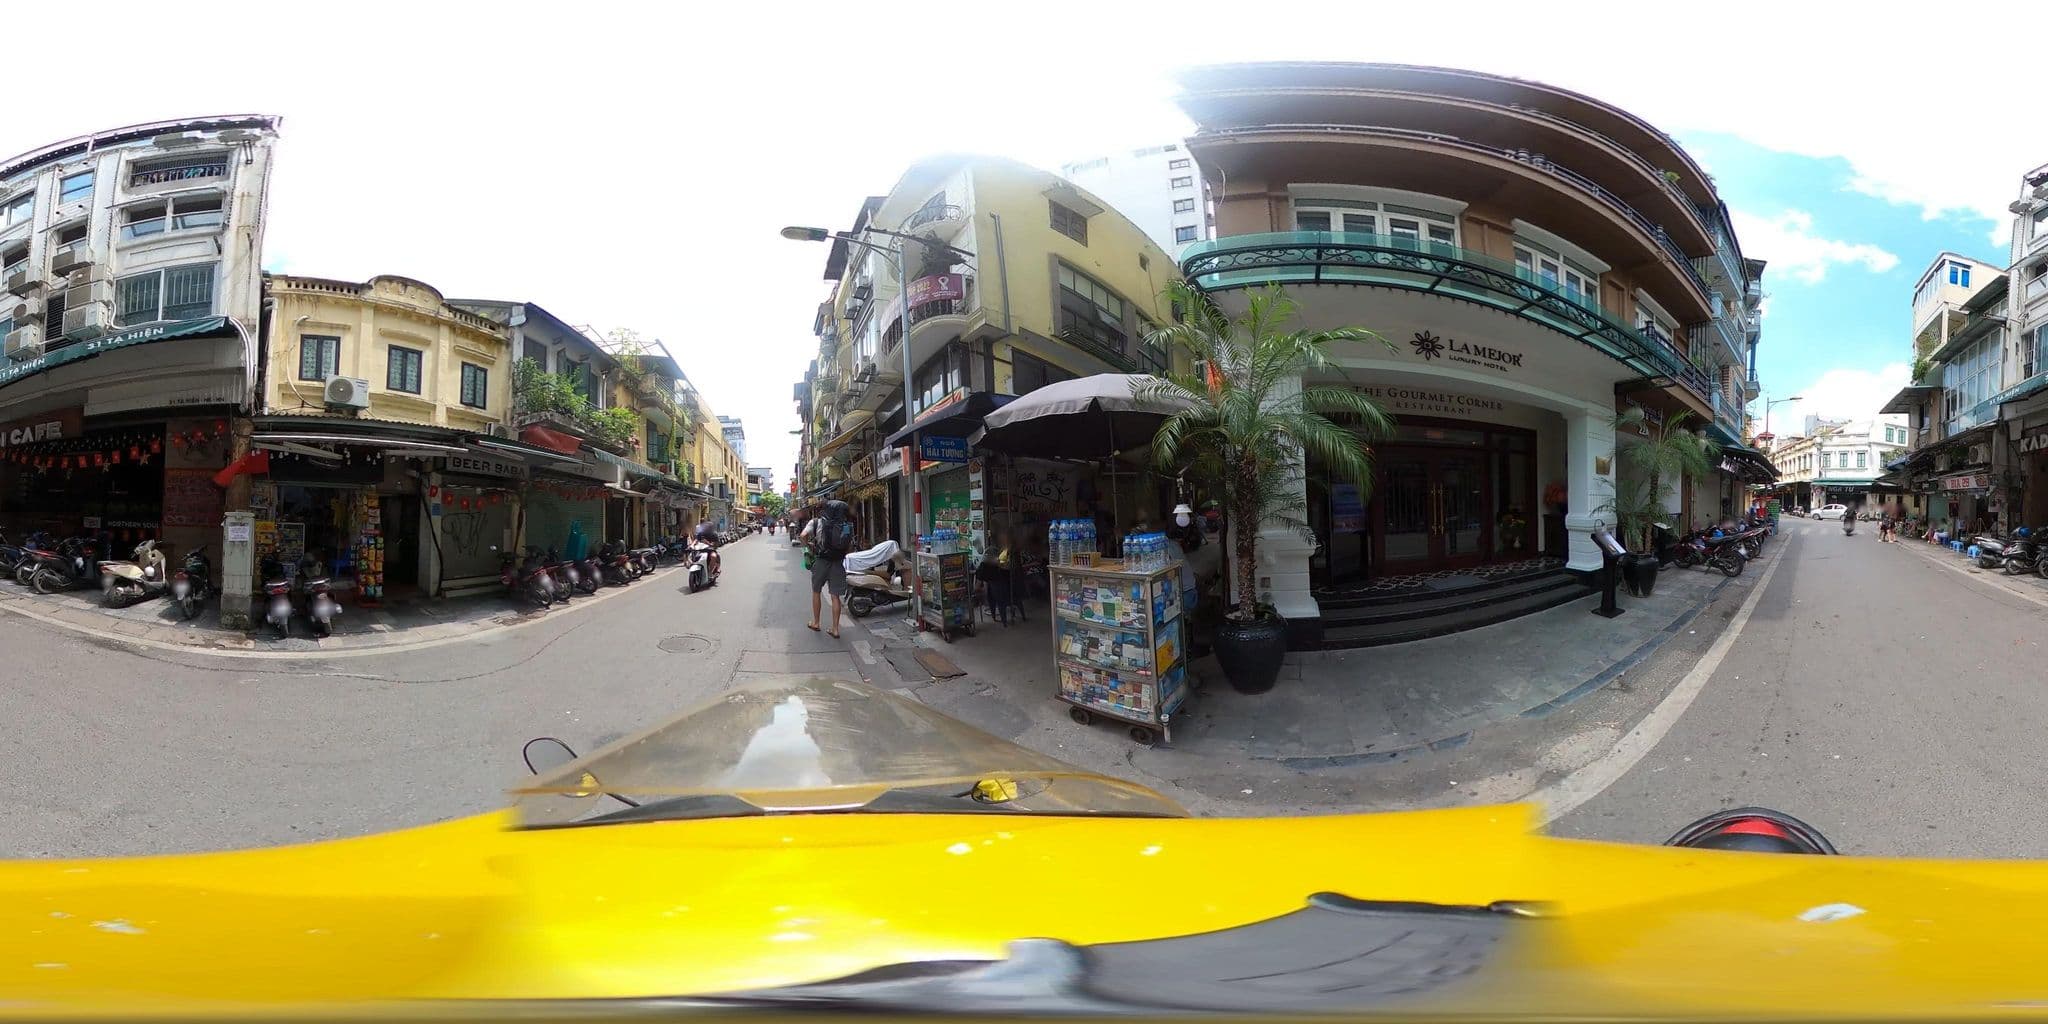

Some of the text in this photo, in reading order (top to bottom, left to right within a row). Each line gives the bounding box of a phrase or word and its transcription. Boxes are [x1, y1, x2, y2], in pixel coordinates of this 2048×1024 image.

[87, 341, 101, 350] 31
[1448, 339, 1522, 367] LA MEJOR
[1448, 355, 1508, 372] LUXURY HOTEL
[1352, 385, 1504, 410] THE GOURMET CORNER
[1395, 401, 1472, 415] RESTAURANT
[10, 421, 63, 445] CAFE
[452, 456, 525, 477] BEER BABA
[859, 457, 873, 480] SPA
[108, 520, 159, 529] NORTHERN SOUL
